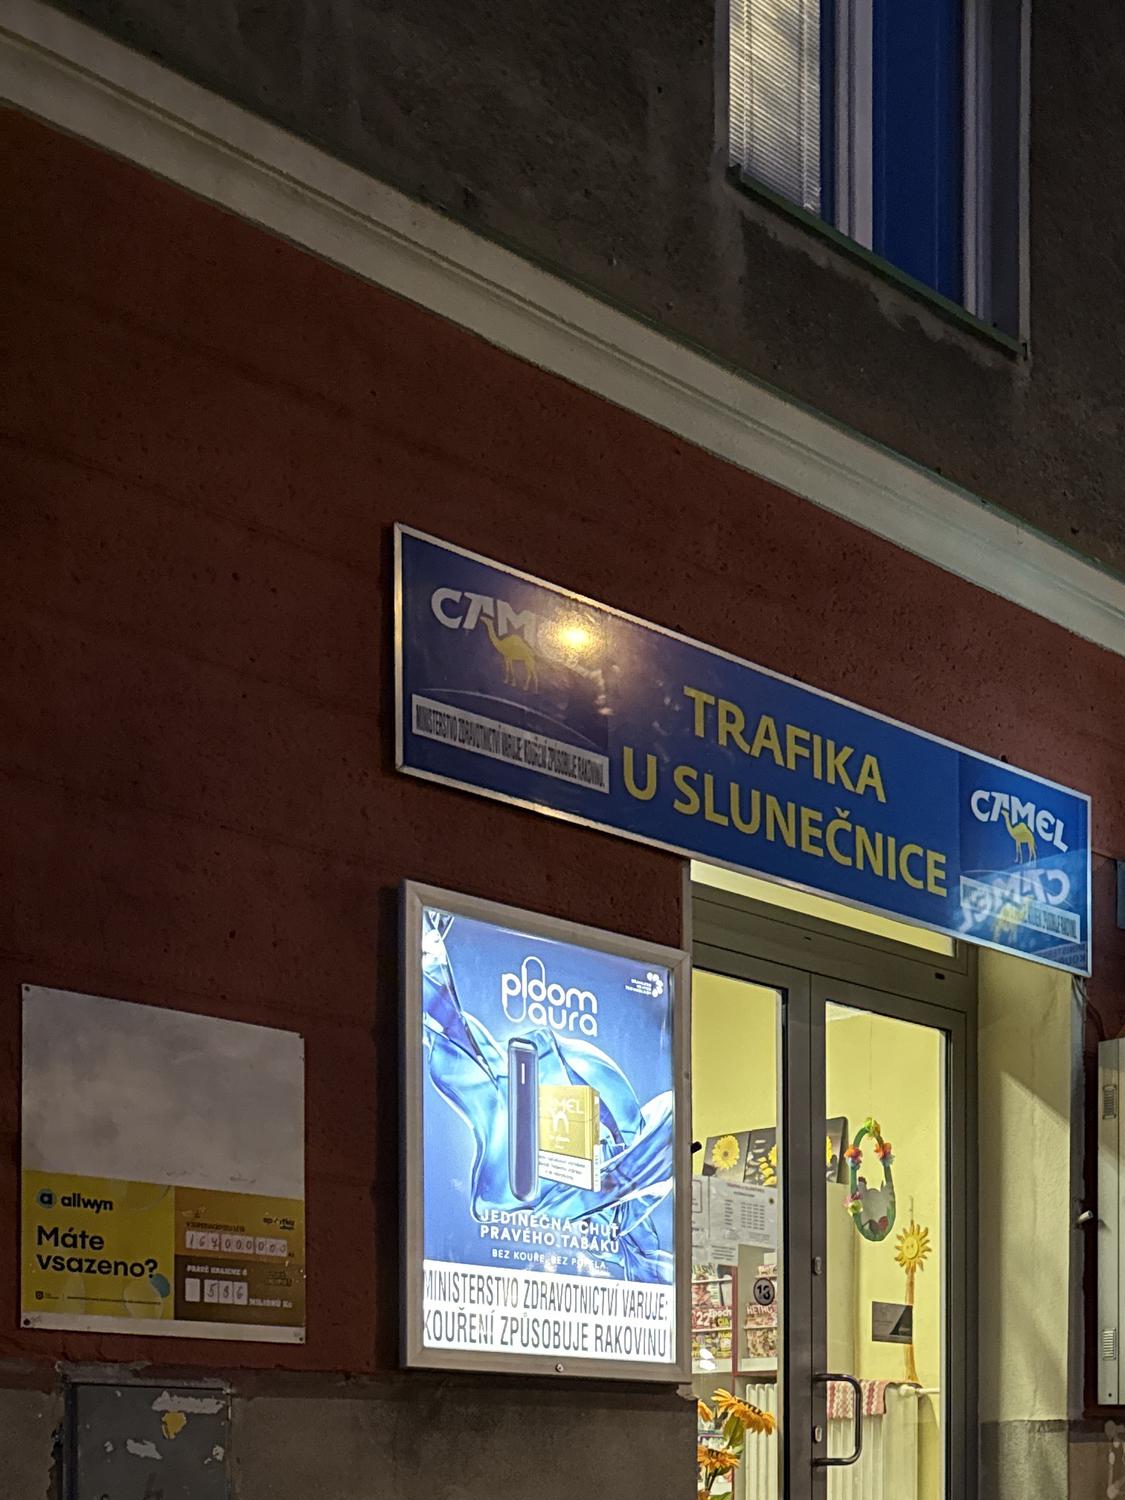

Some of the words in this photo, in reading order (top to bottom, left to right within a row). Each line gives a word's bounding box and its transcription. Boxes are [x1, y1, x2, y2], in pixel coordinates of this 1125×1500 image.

[683, 686, 887, 804] TRAFIKA
[623, 746, 657, 801] U
[673, 765, 948, 898] SLUNEČNICE
[971, 790, 1069, 853] CAMEL
[501, 956, 598, 1021] ploom
[527, 1002, 598, 1037] aura
[61, 1193, 113, 1214] allwyn
[480, 1209, 573, 1233] JEDINEČNÁ
[37, 1225, 104, 1250] Máte
[480, 1225, 556, 1246] PRAVÉHO
[561, 1234, 619, 1254] TABÁKU
[36, 1254, 158, 1279] vsazeno?
[492, 1248, 511, 1260] BEZ
[551, 1255, 569, 1266] BEZ
[424, 1268, 519, 1309] MINISTERSTVO
[523, 1279, 618, 1318] ZDRAVOTNICTVÍ
[622, 1288, 669, 1321] VARUJE:
[424, 1306, 495, 1346] KOUŘENÍ
[500, 1312, 589, 1352] ZPŮSOBUJE
[594, 1323, 667, 1358] RAKOVINU
